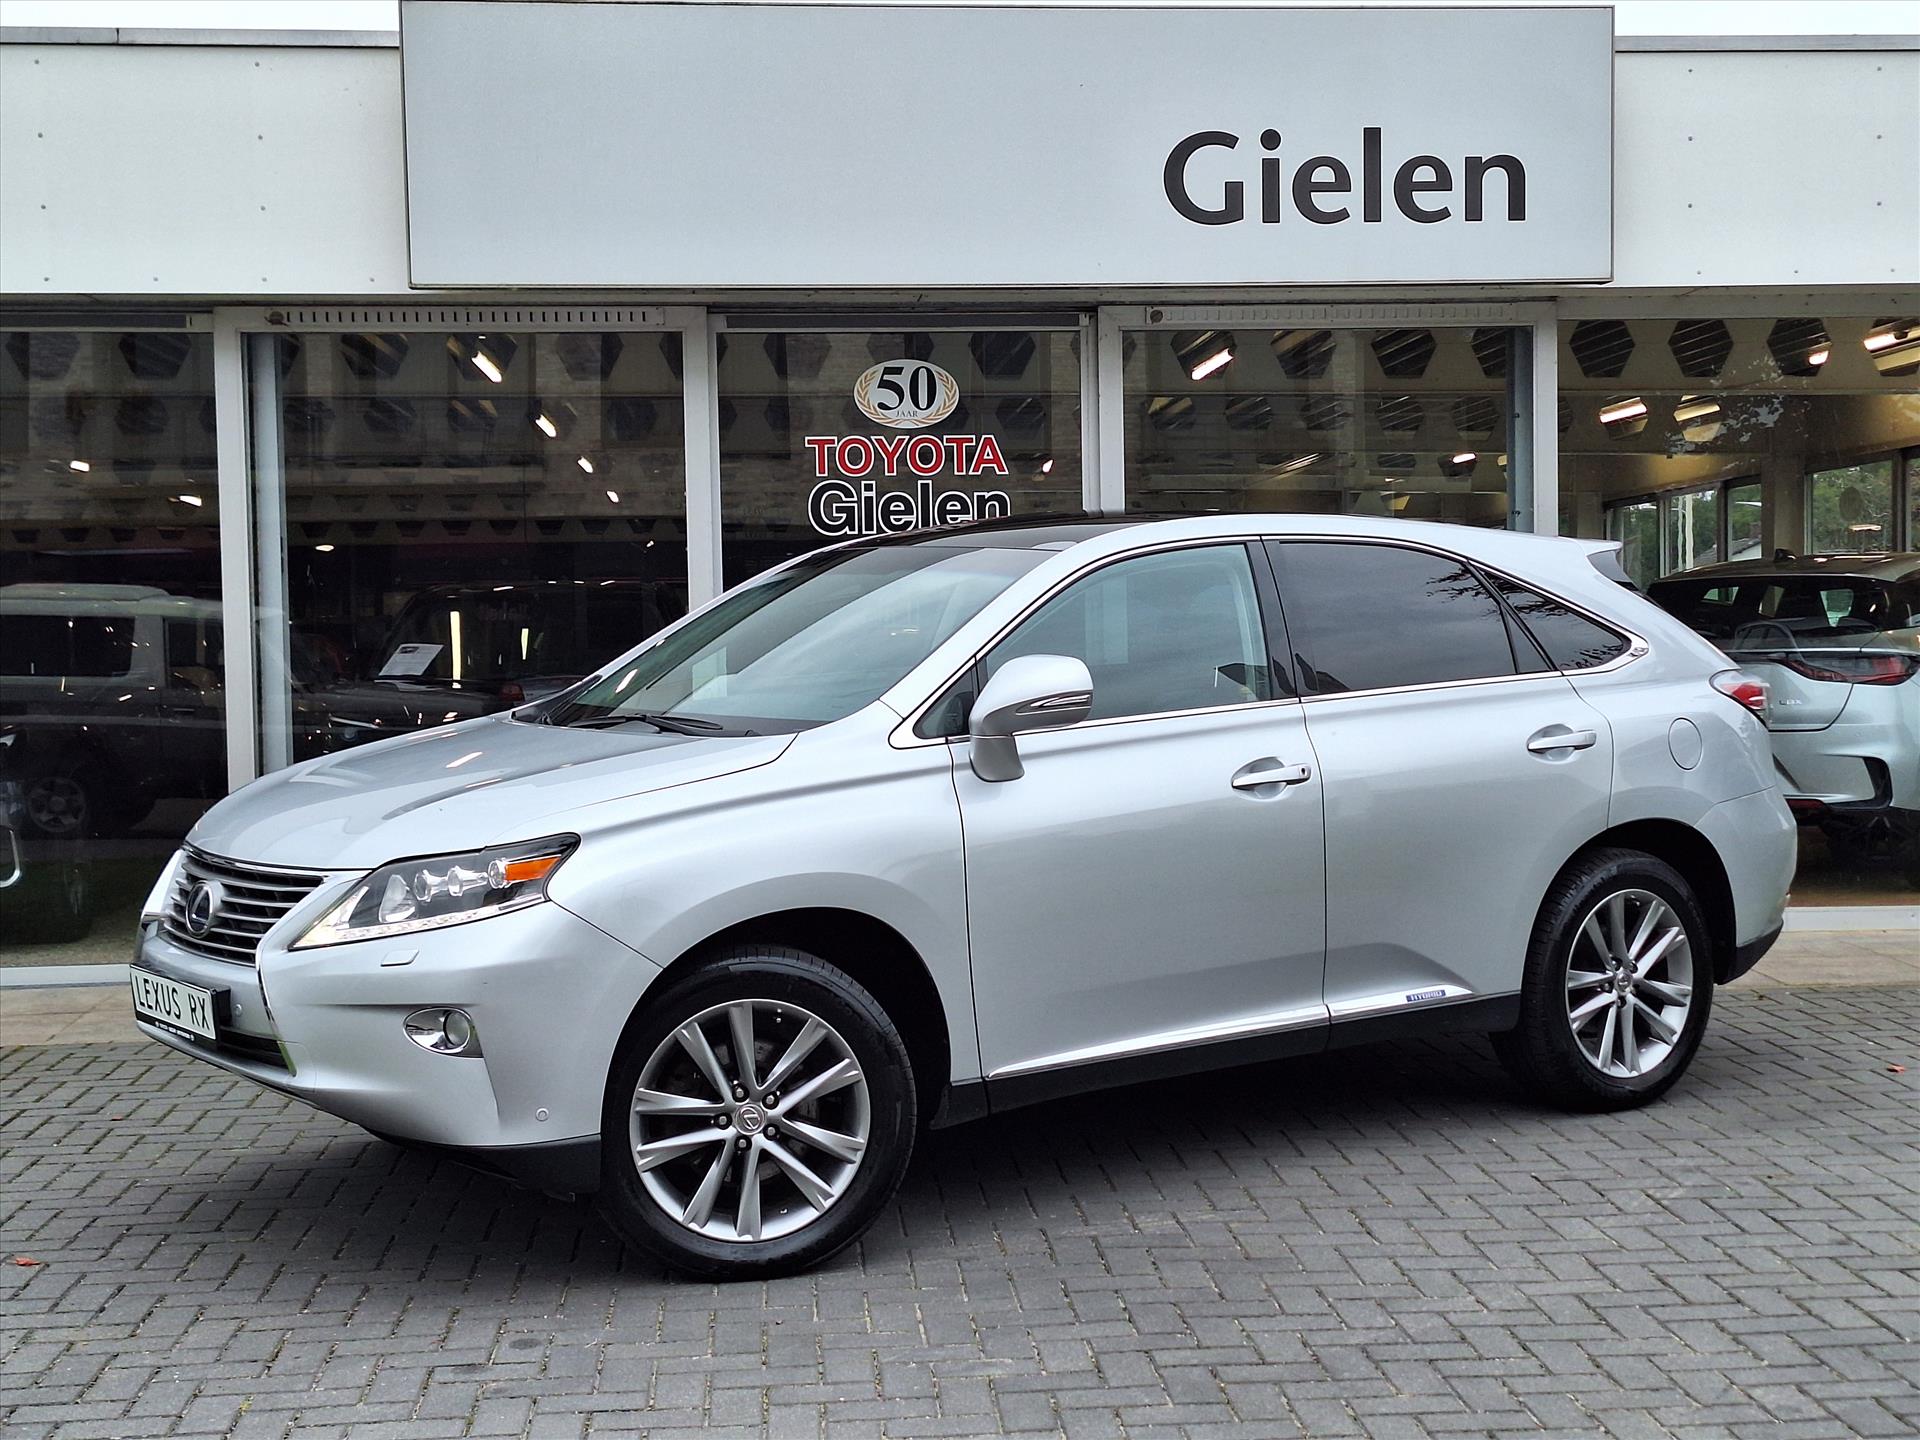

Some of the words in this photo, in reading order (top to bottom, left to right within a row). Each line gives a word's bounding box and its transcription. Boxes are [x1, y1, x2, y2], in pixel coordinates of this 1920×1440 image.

[1163, 127, 1526, 226] Gielen
[876, 365, 938, 411] 50
[895, 410, 919, 418] JAAR
[804, 434, 1010, 477] TOYOTA
[807, 479, 1012, 537] Gielen
[135, 975, 181, 1020] LEXUS
[187, 993, 210, 1031] RX
